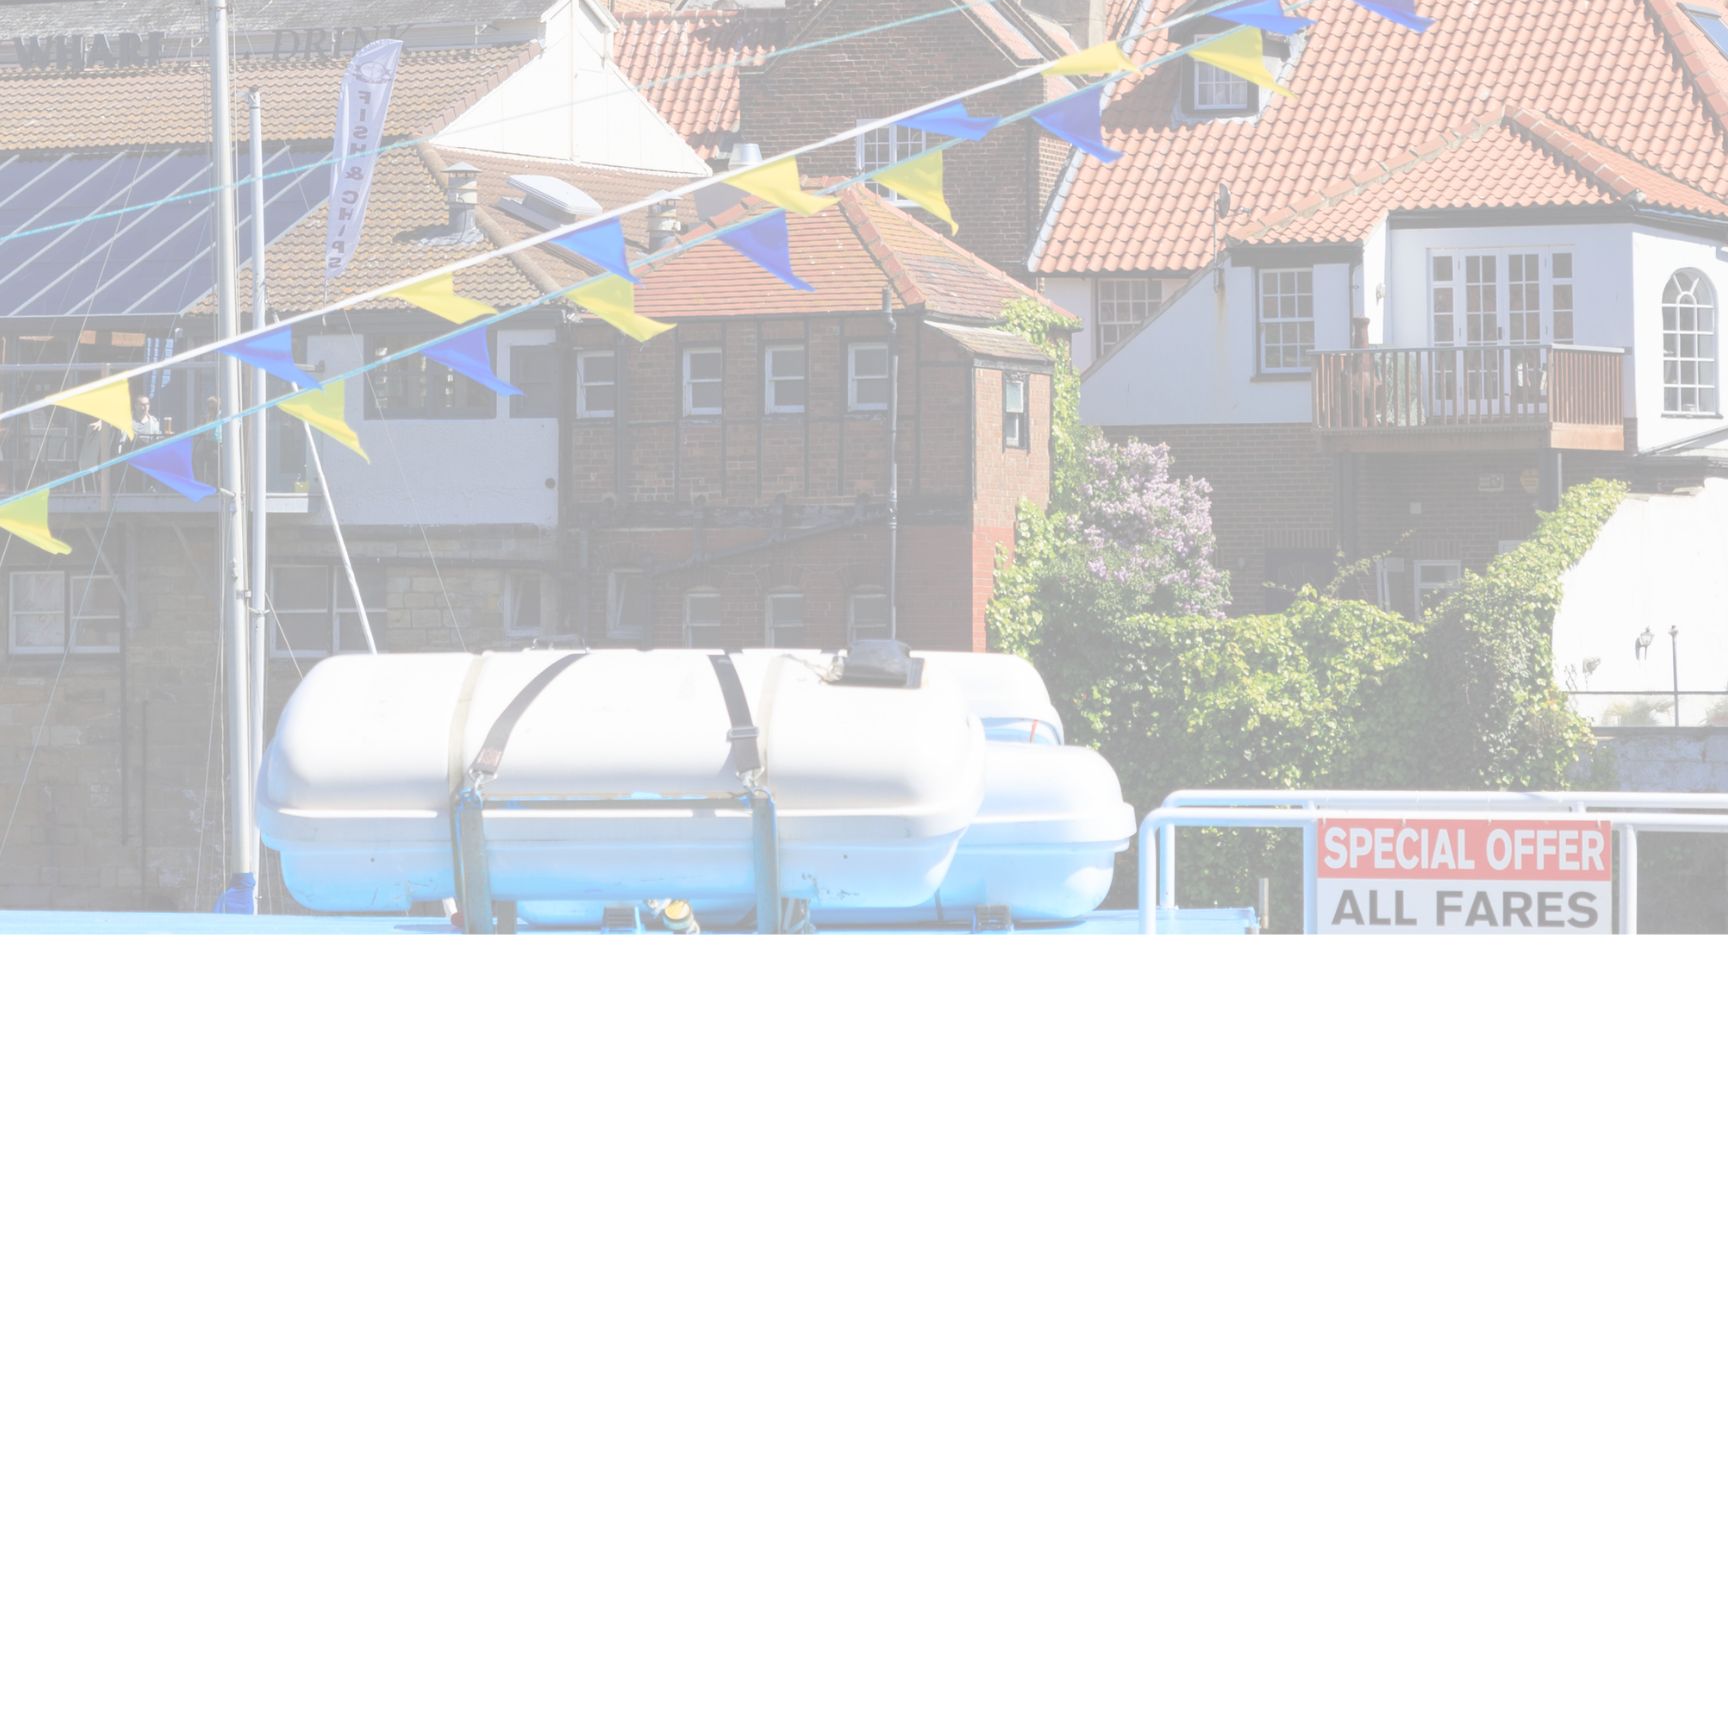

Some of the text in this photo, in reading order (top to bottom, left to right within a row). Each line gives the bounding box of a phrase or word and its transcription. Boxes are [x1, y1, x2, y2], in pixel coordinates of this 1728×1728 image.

[15, 30, 165, 71] WHARF
[1323, 826, 1605, 871] SPECIAL OFFER
[1331, 889, 1599, 929] ALL FARES
